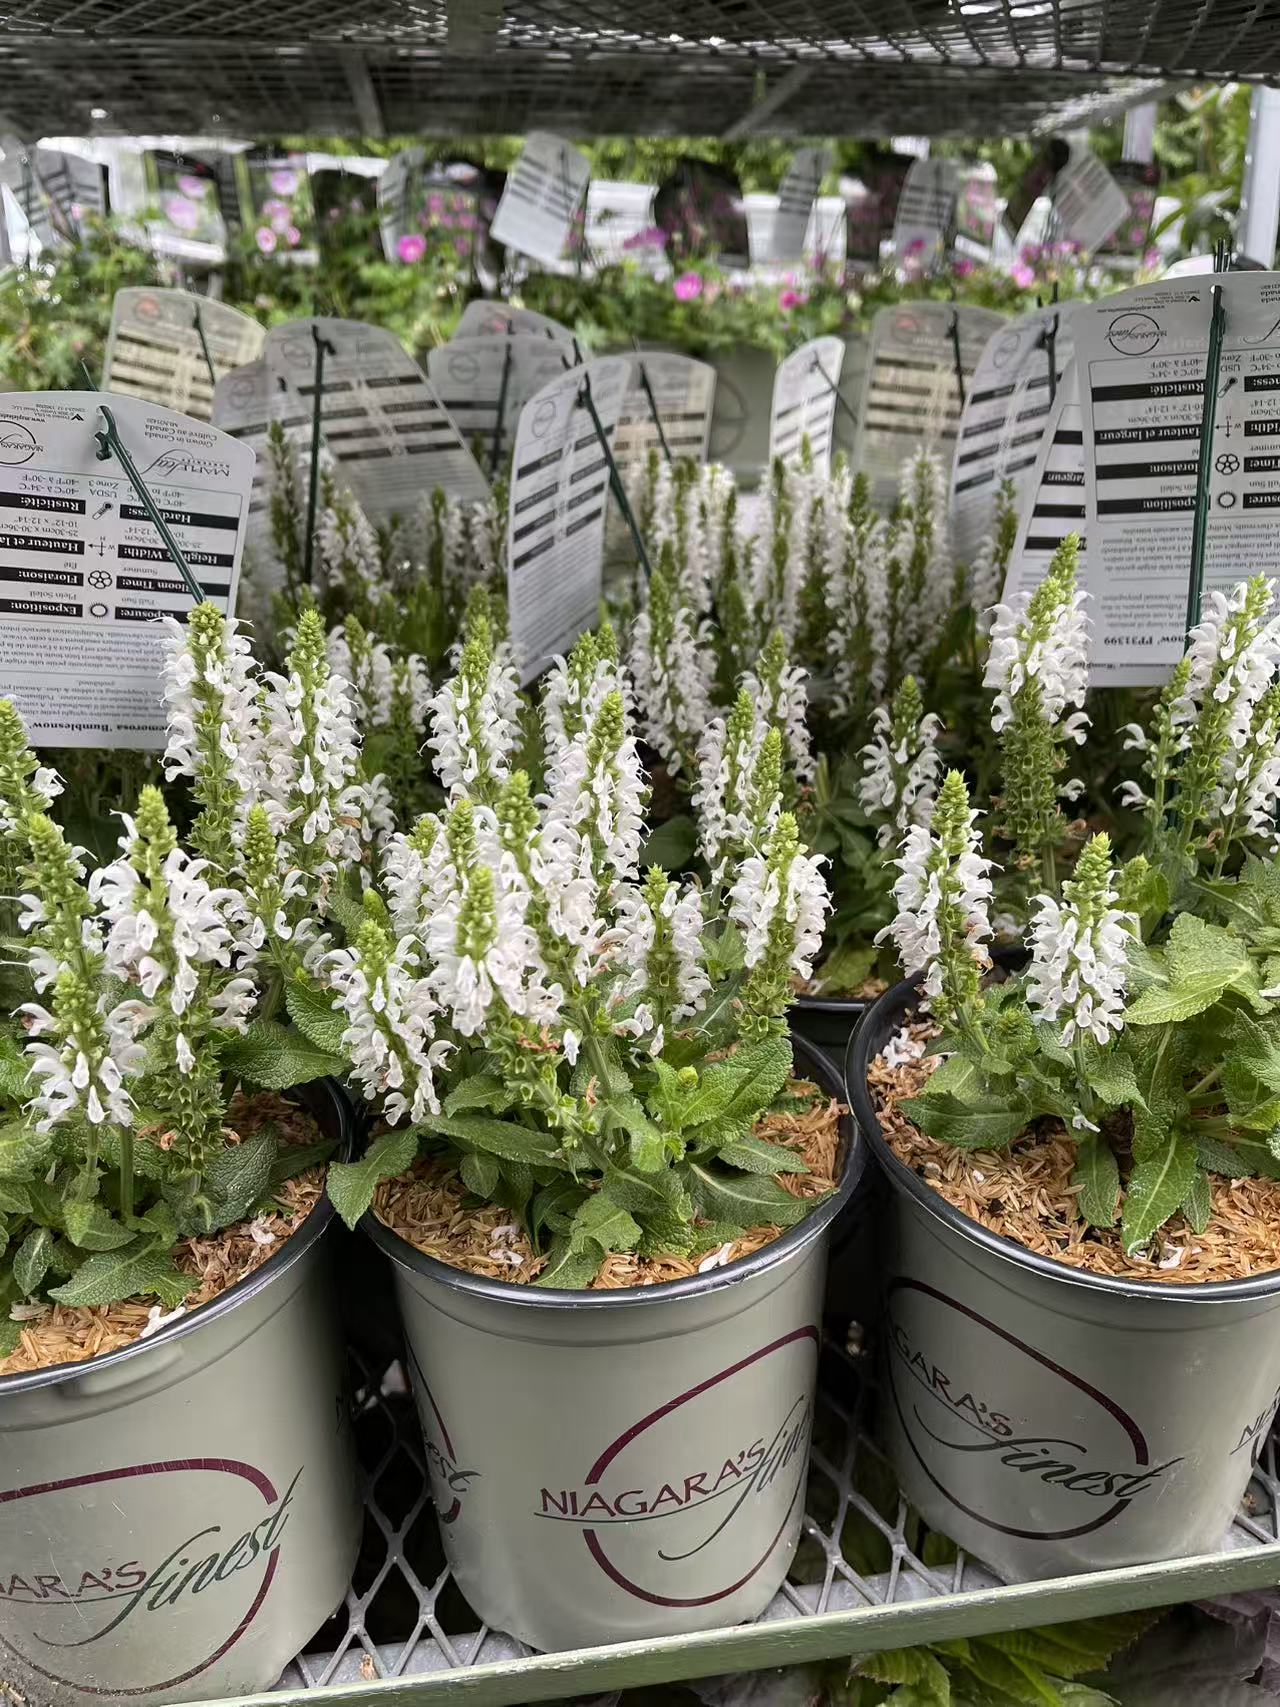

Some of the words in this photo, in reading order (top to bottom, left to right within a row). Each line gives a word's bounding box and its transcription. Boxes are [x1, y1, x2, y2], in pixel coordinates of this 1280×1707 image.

[1221, 354, 1241, 362] Zon
[1220, 364, 1240, 372] USD
[1250, 364, 1274, 372] -34°C
[1253, 378, 1280, 386] ness:
[1150, 382, 1204, 395] Rusticité:
[1250, 408, 1280, 416] 0-36cm
[1128, 416, 1161, 424] 30-36cm
[144, 424, 176, 434] Canada
[176, 428, 186, 436] au
[1250, 422, 1280, 432] idth:
[144, 431, 175, 442] Canada
[188, 430, 217, 442] Cultivé
[1100, 430, 1142, 440] largeur:
[1145, 430, 1155, 438] et
[176, 436, 184, 444] in
[186, 438, 213, 448] Grown
[0, 442, 44, 452] NIAGARA'S
[1250, 444, 1280, 452] ummer
[1150, 462, 1198, 474] loraison:
[20, 474, 46, 482] -30°F
[48, 476, 54, 484] à
[55, 477, 80, 486] -40°F
[18, 482, 45, 492] -34°C
[96, 480, 119, 489] Zone
[1249, 480, 1266, 488] Sun
[46, 486, 52, 494] à
[54, 486, 80, 495] -40°C
[89, 488, 117, 498] USDA
[20, 496, 80, 511] Rusticité:
[1142, 497, 1196, 510] xposition:
[1248, 495, 1280, 504] osure:
[128, 508, 191, 523] Hardess:
[42, 527, 78, 538] 25-30cm
[13, 537, 25, 546] et
[28, 538, 78, 552] Hauteur
[124, 547, 163, 559] Width:
[182, 552, 217, 564] Heigh
[122, 566, 158, 576] Summer
[18, 570, 78, 584] Floraison:
[122, 578, 154, 590] Time:
[28, 590, 54, 598] Soleil
[54, 592, 77, 600] Plein
[10, 602, 77, 615] Exposition:
[120, 609, 174, 618] Exposure:
[913, 1404, 1185, 1498] finest
[540, 1438, 765, 1517] NIAGARA'S
[33, 1465, 305, 1647] finest
[0, 1560, 147, 1599] ARA'S
